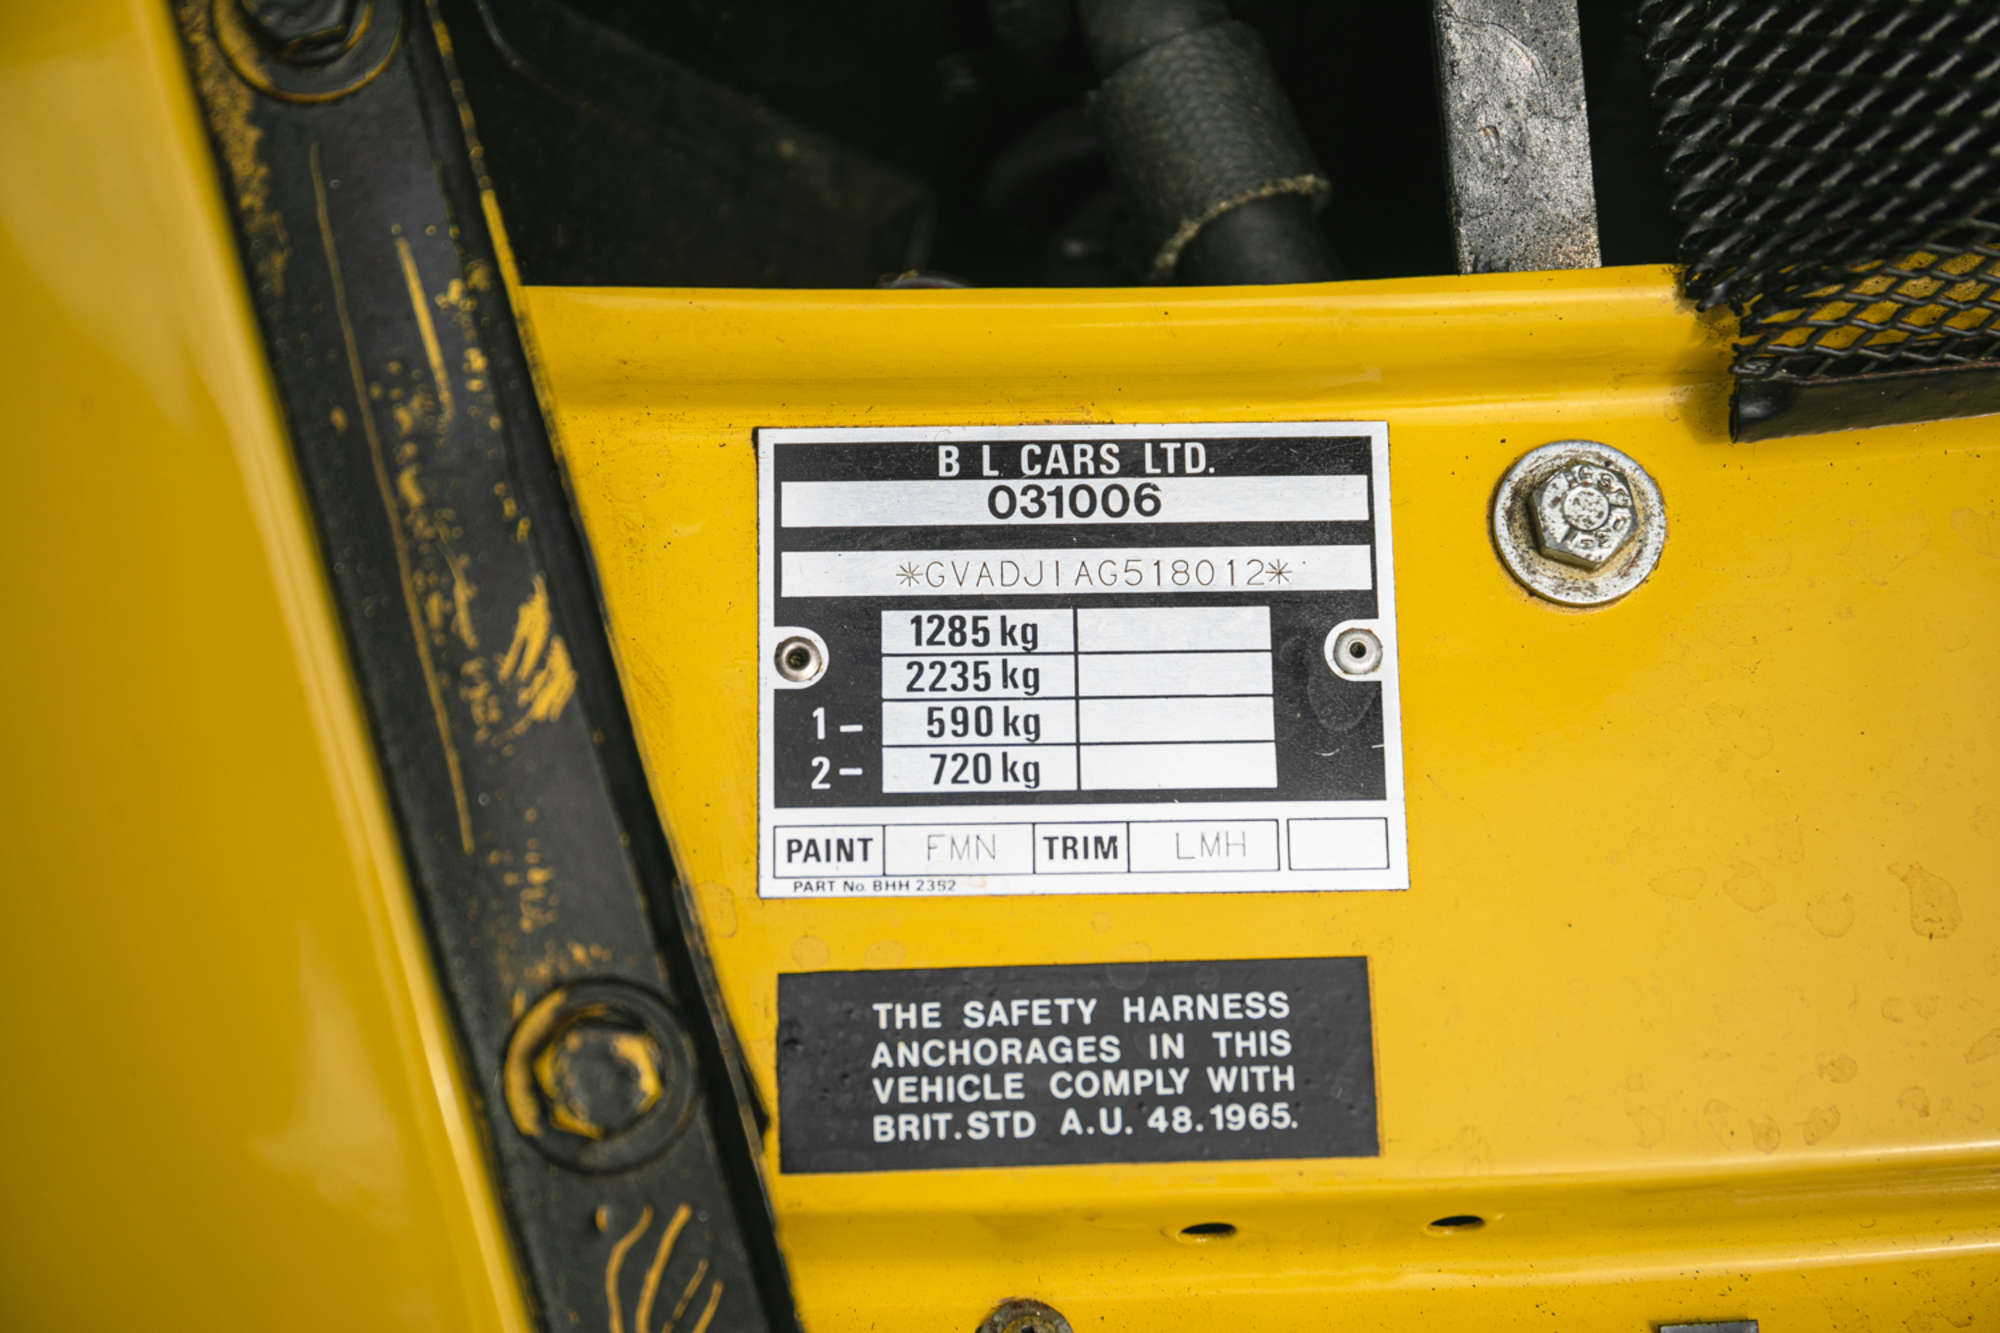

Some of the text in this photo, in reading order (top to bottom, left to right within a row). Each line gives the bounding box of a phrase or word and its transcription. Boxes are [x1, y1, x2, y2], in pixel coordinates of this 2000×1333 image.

[937, 441, 1216, 478] B L CARS LTD.
[987, 482, 1162, 520] 031006
[909, 613, 1040, 653] 1285 kg
[904, 657, 1041, 697] 2235 kg
[926, 705, 994, 739] 590
[1002, 703, 1042, 743] kg
[929, 752, 992, 786] 720
[1001, 751, 1041, 790] kg
[786, 831, 1246, 864] PAINT FMN TRIM LMH
[793, 880, 835, 893] PART
[872, 880, 910, 892] BHH
[872, 991, 1290, 1030] THE SAFETY HARNESS
[871, 1028, 1292, 1069] ANCHORAGES IN THIS
[872, 1064, 1295, 1104] VEHICLE COMPLY WITH
[873, 1110, 1037, 1143] BRIT.STD
[1060, 1106, 1133, 1136] A.U.
